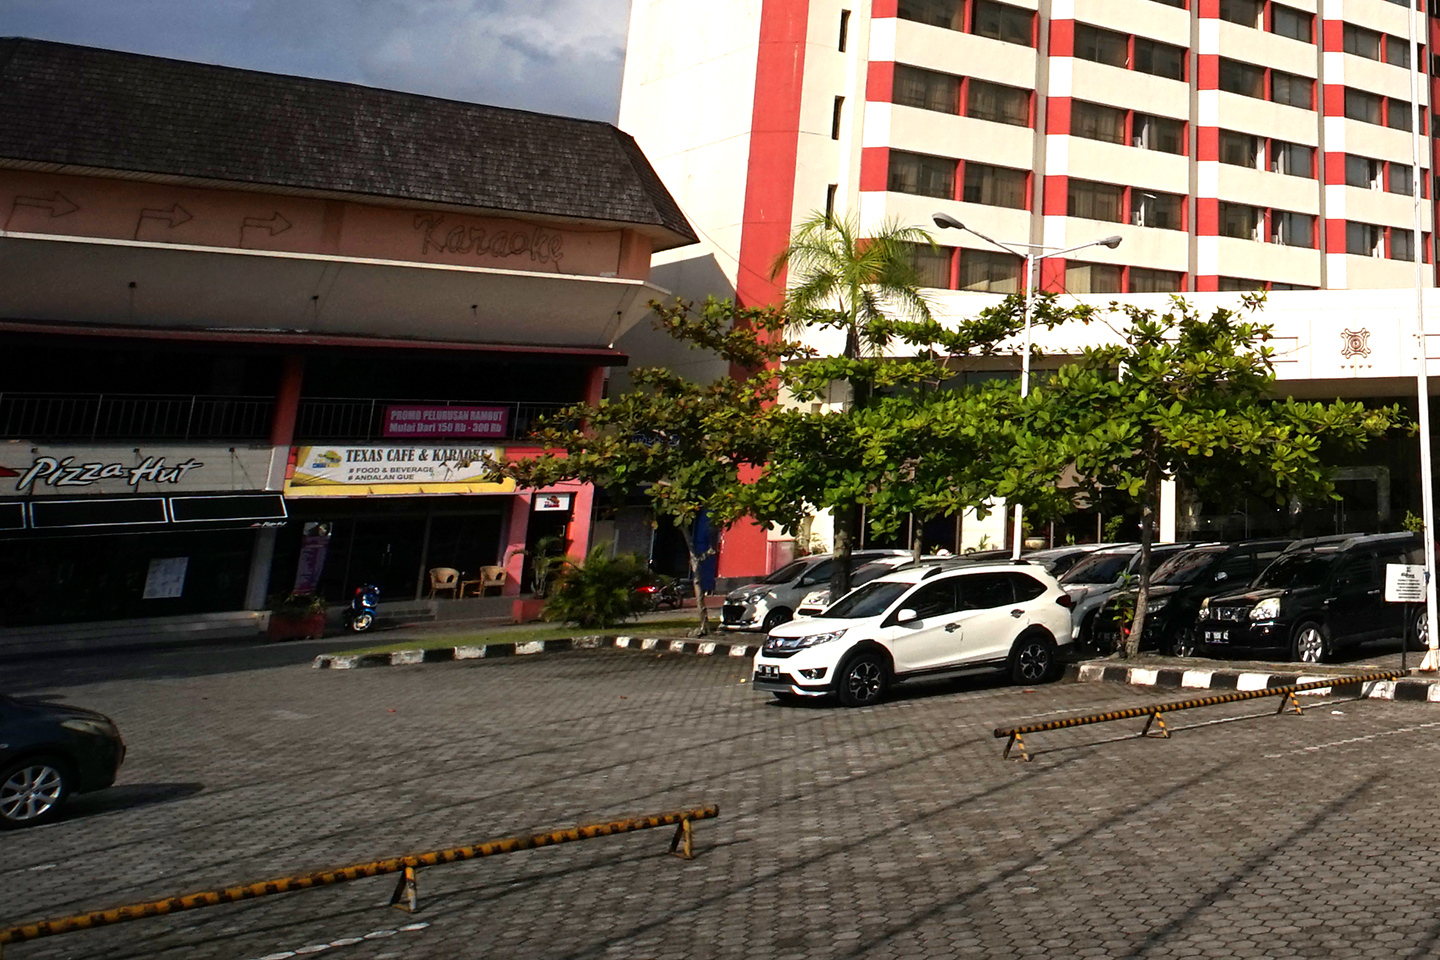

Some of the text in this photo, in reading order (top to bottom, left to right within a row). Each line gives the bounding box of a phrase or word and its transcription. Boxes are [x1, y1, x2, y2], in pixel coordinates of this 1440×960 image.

[413, 213, 564, 264] Karaoke
[390, 409, 504, 421] PROMO PELURUSAN RAMBUT
[389, 422, 416, 433] Mulai
[416, 422, 436, 433] Dari
[437, 422, 453, 433] 150
[454, 422, 466, 433] Rb
[472, 423, 489, 433] 300
[490, 423, 502, 433] Rb
[346, 448, 383, 462] TEXAS
[387, 446, 415, 462] CAFÉ
[418, 448, 429, 461] &
[16, 455, 204, 491] Pizza Hut
[389, 466, 434, 474] BEVERAGE
